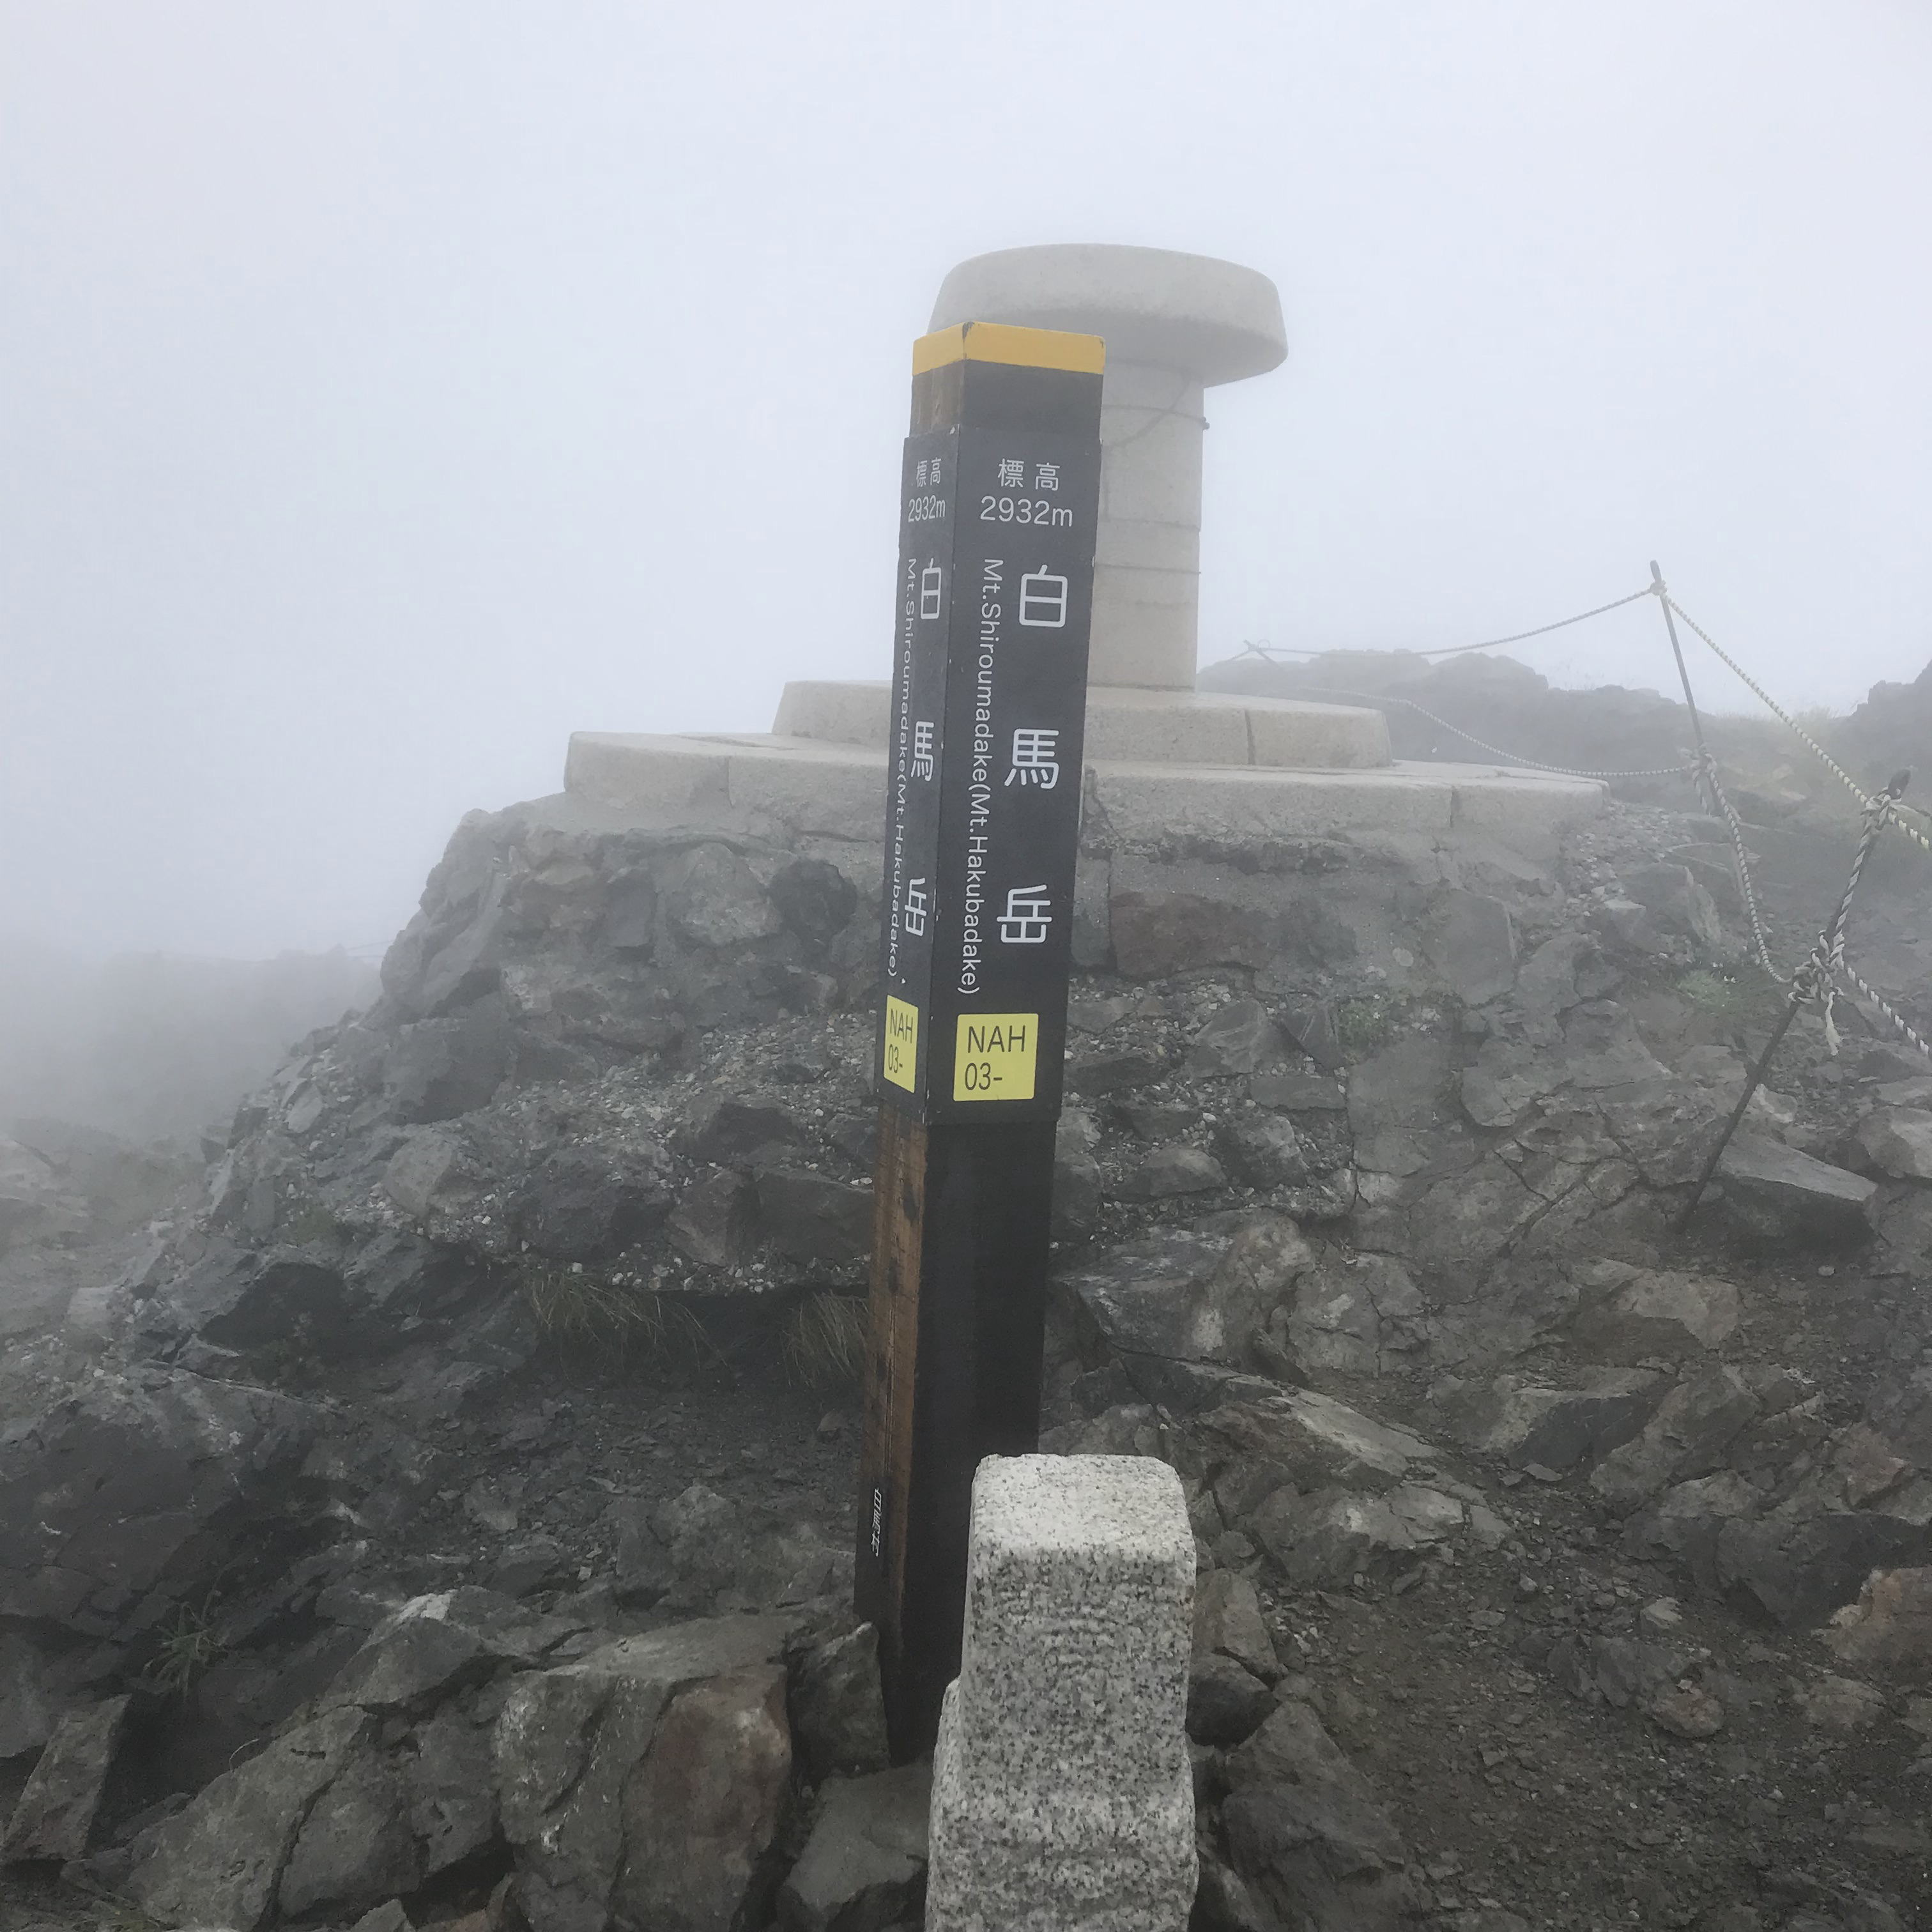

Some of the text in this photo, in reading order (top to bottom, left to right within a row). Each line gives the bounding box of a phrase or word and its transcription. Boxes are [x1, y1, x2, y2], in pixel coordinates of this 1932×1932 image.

[916, 457, 942, 487] 標高
[997, 458, 1061, 491] 標高
[907, 495, 946, 523] 2932m
[979, 495, 1073, 527] 2932m
[997, 564, 1068, 944] 白馬岳
[889, 1008, 914, 1044] NAH
[967, 1025, 1026, 1053] NAH
[887, 1043, 903, 1074] 03-
[964, 1062, 1003, 1091] 03-
